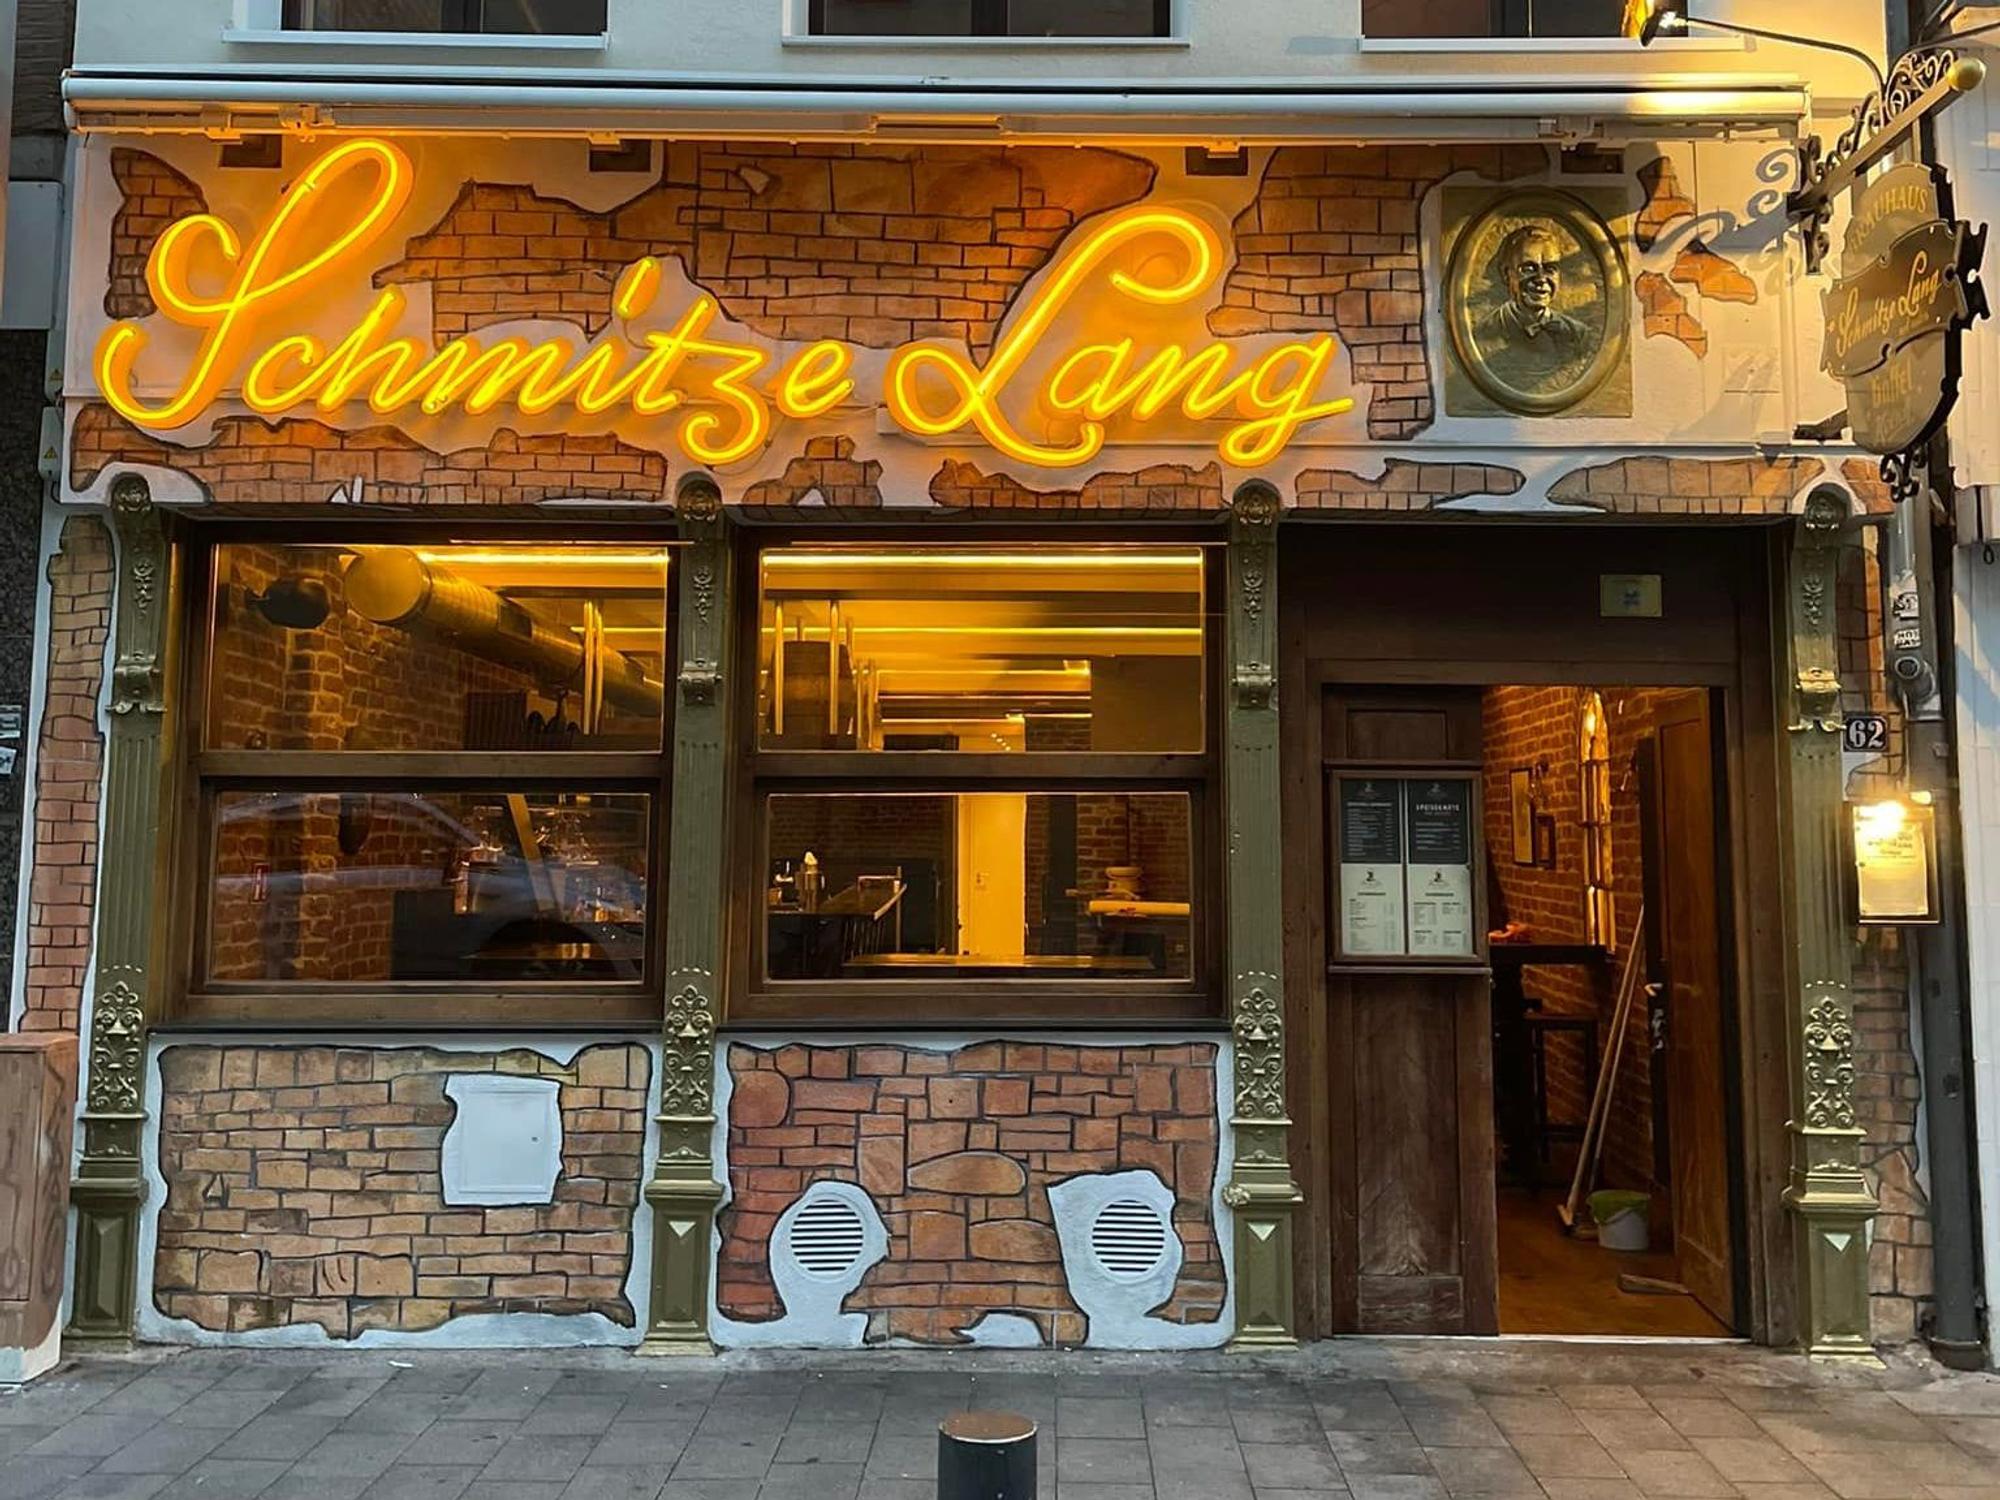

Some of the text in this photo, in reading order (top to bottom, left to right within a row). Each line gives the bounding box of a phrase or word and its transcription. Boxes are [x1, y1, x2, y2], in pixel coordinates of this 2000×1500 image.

[97, 138, 1354, 466] Schmitze Lang
[1836, 250, 1942, 357] Schmitze Lang
[1849, 719, 1884, 748] 62
